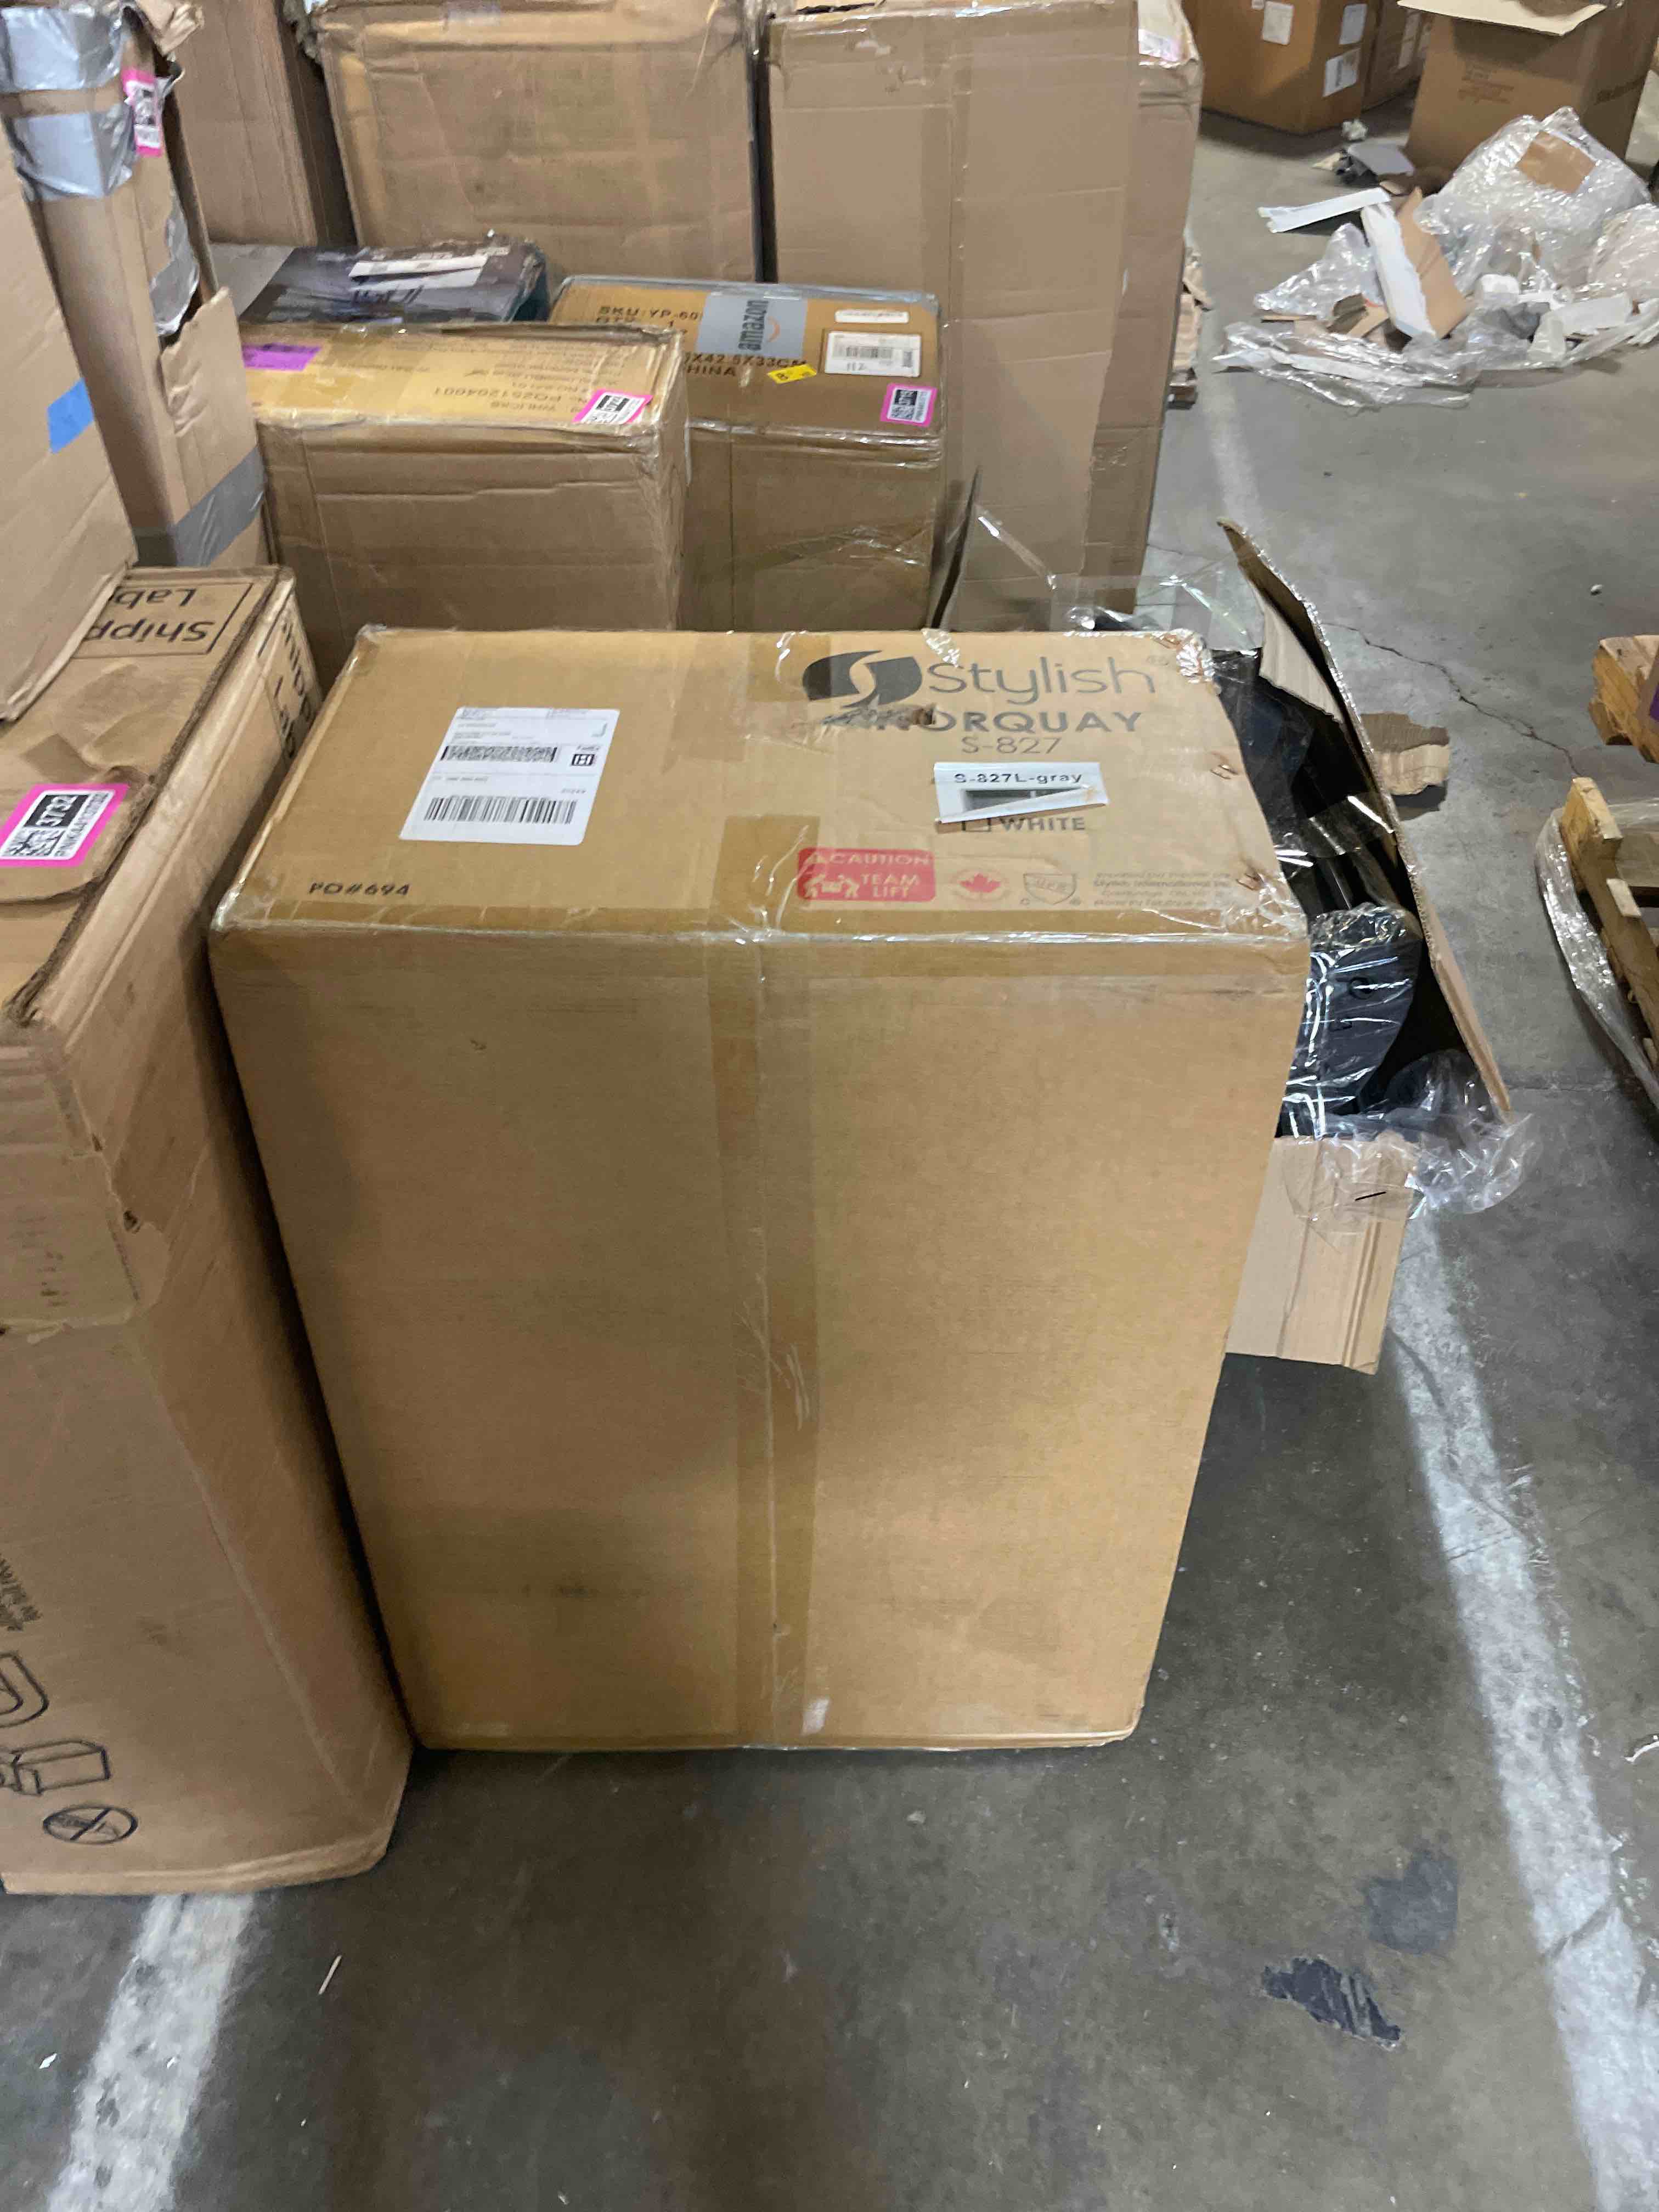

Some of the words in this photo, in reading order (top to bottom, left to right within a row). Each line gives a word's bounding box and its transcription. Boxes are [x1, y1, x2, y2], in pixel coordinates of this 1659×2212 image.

[738, 300, 768, 351] amazon
[928, 656, 1155, 706] Stylish
[876, 710, 1142, 733] ORQUAY
[961, 736, 1063, 754] S-827
[954, 773, 1082, 785] S-827L-gray
[1000, 817, 1085, 831] WHITE
[830, 854, 930, 865] CAUTION
[860, 874, 919, 886] TEAM
[309, 882, 411, 895] PO#694
[873, 885, 910, 898] LIFT
